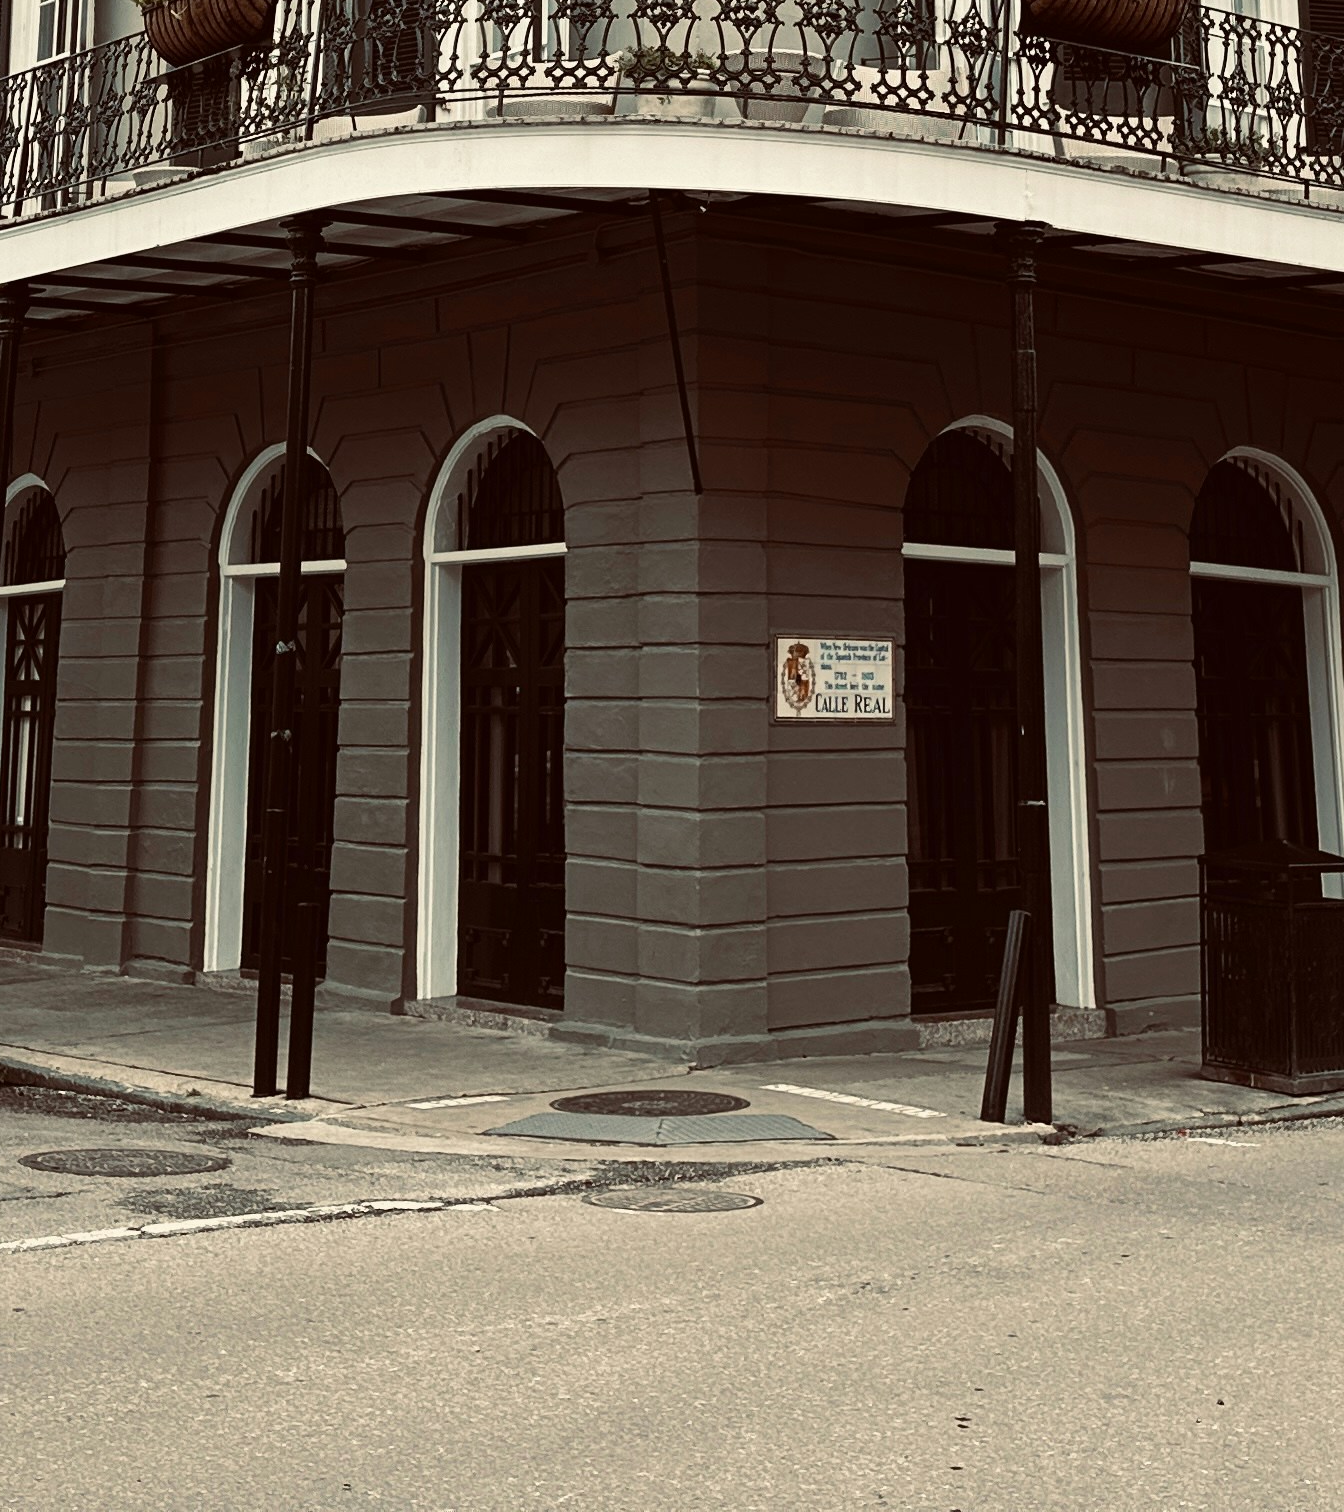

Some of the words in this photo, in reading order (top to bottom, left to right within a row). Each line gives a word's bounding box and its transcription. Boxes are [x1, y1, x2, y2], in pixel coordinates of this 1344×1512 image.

[835, 652, 851, 663] Spanish
[815, 693, 848, 713] CALLE
[854, 693, 890, 714] REAL
